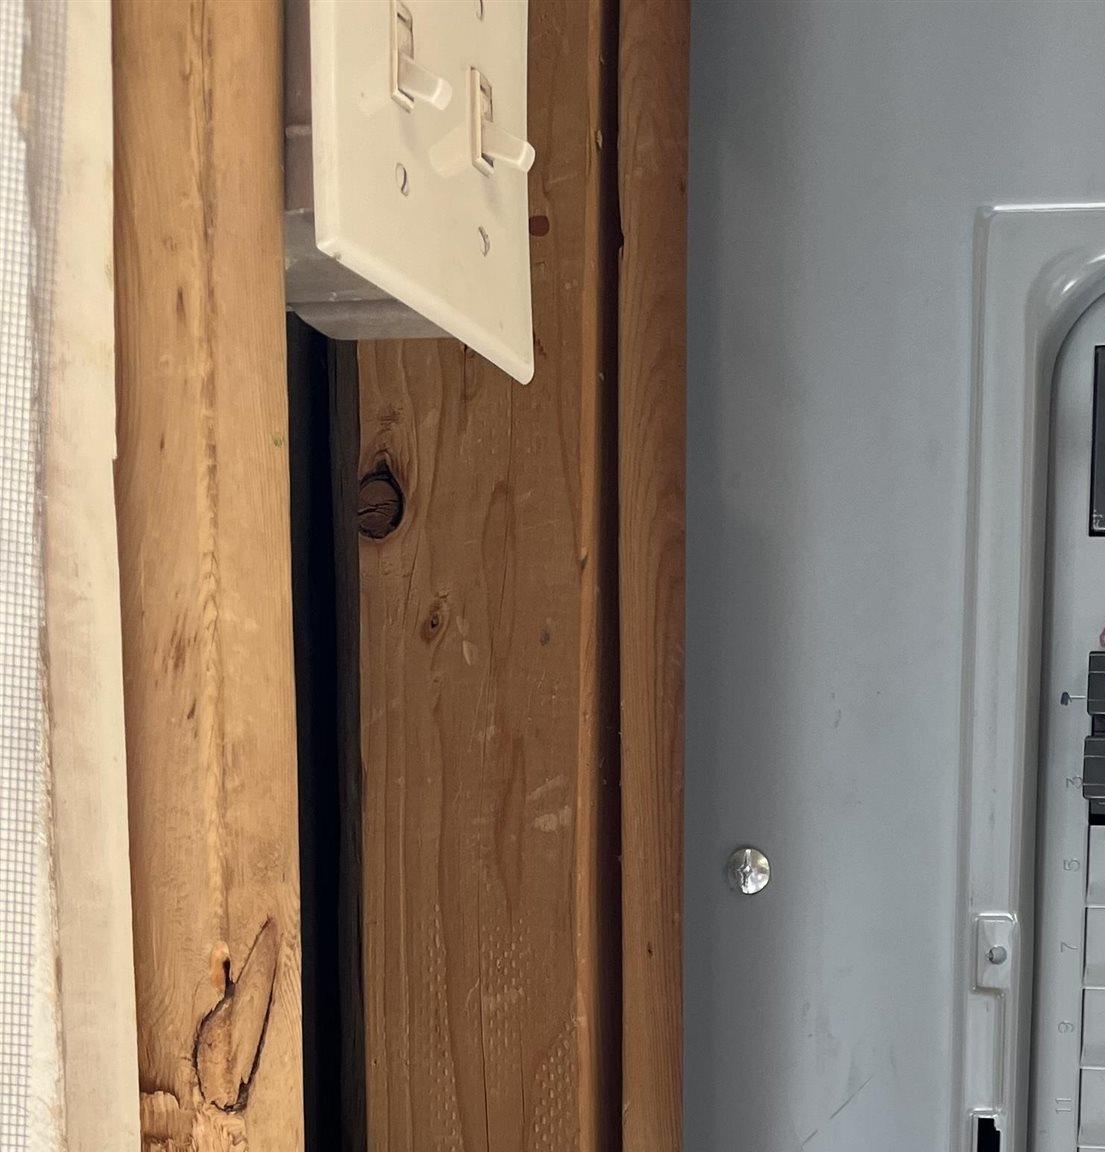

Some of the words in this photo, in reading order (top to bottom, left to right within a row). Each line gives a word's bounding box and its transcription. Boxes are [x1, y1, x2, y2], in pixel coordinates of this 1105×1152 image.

[1064, 859, 1080, 871] 5
[1061, 943, 1078, 952] 7
[1059, 1022, 1074, 1034] 9
[1057, 1099, 1072, 1112] 11
